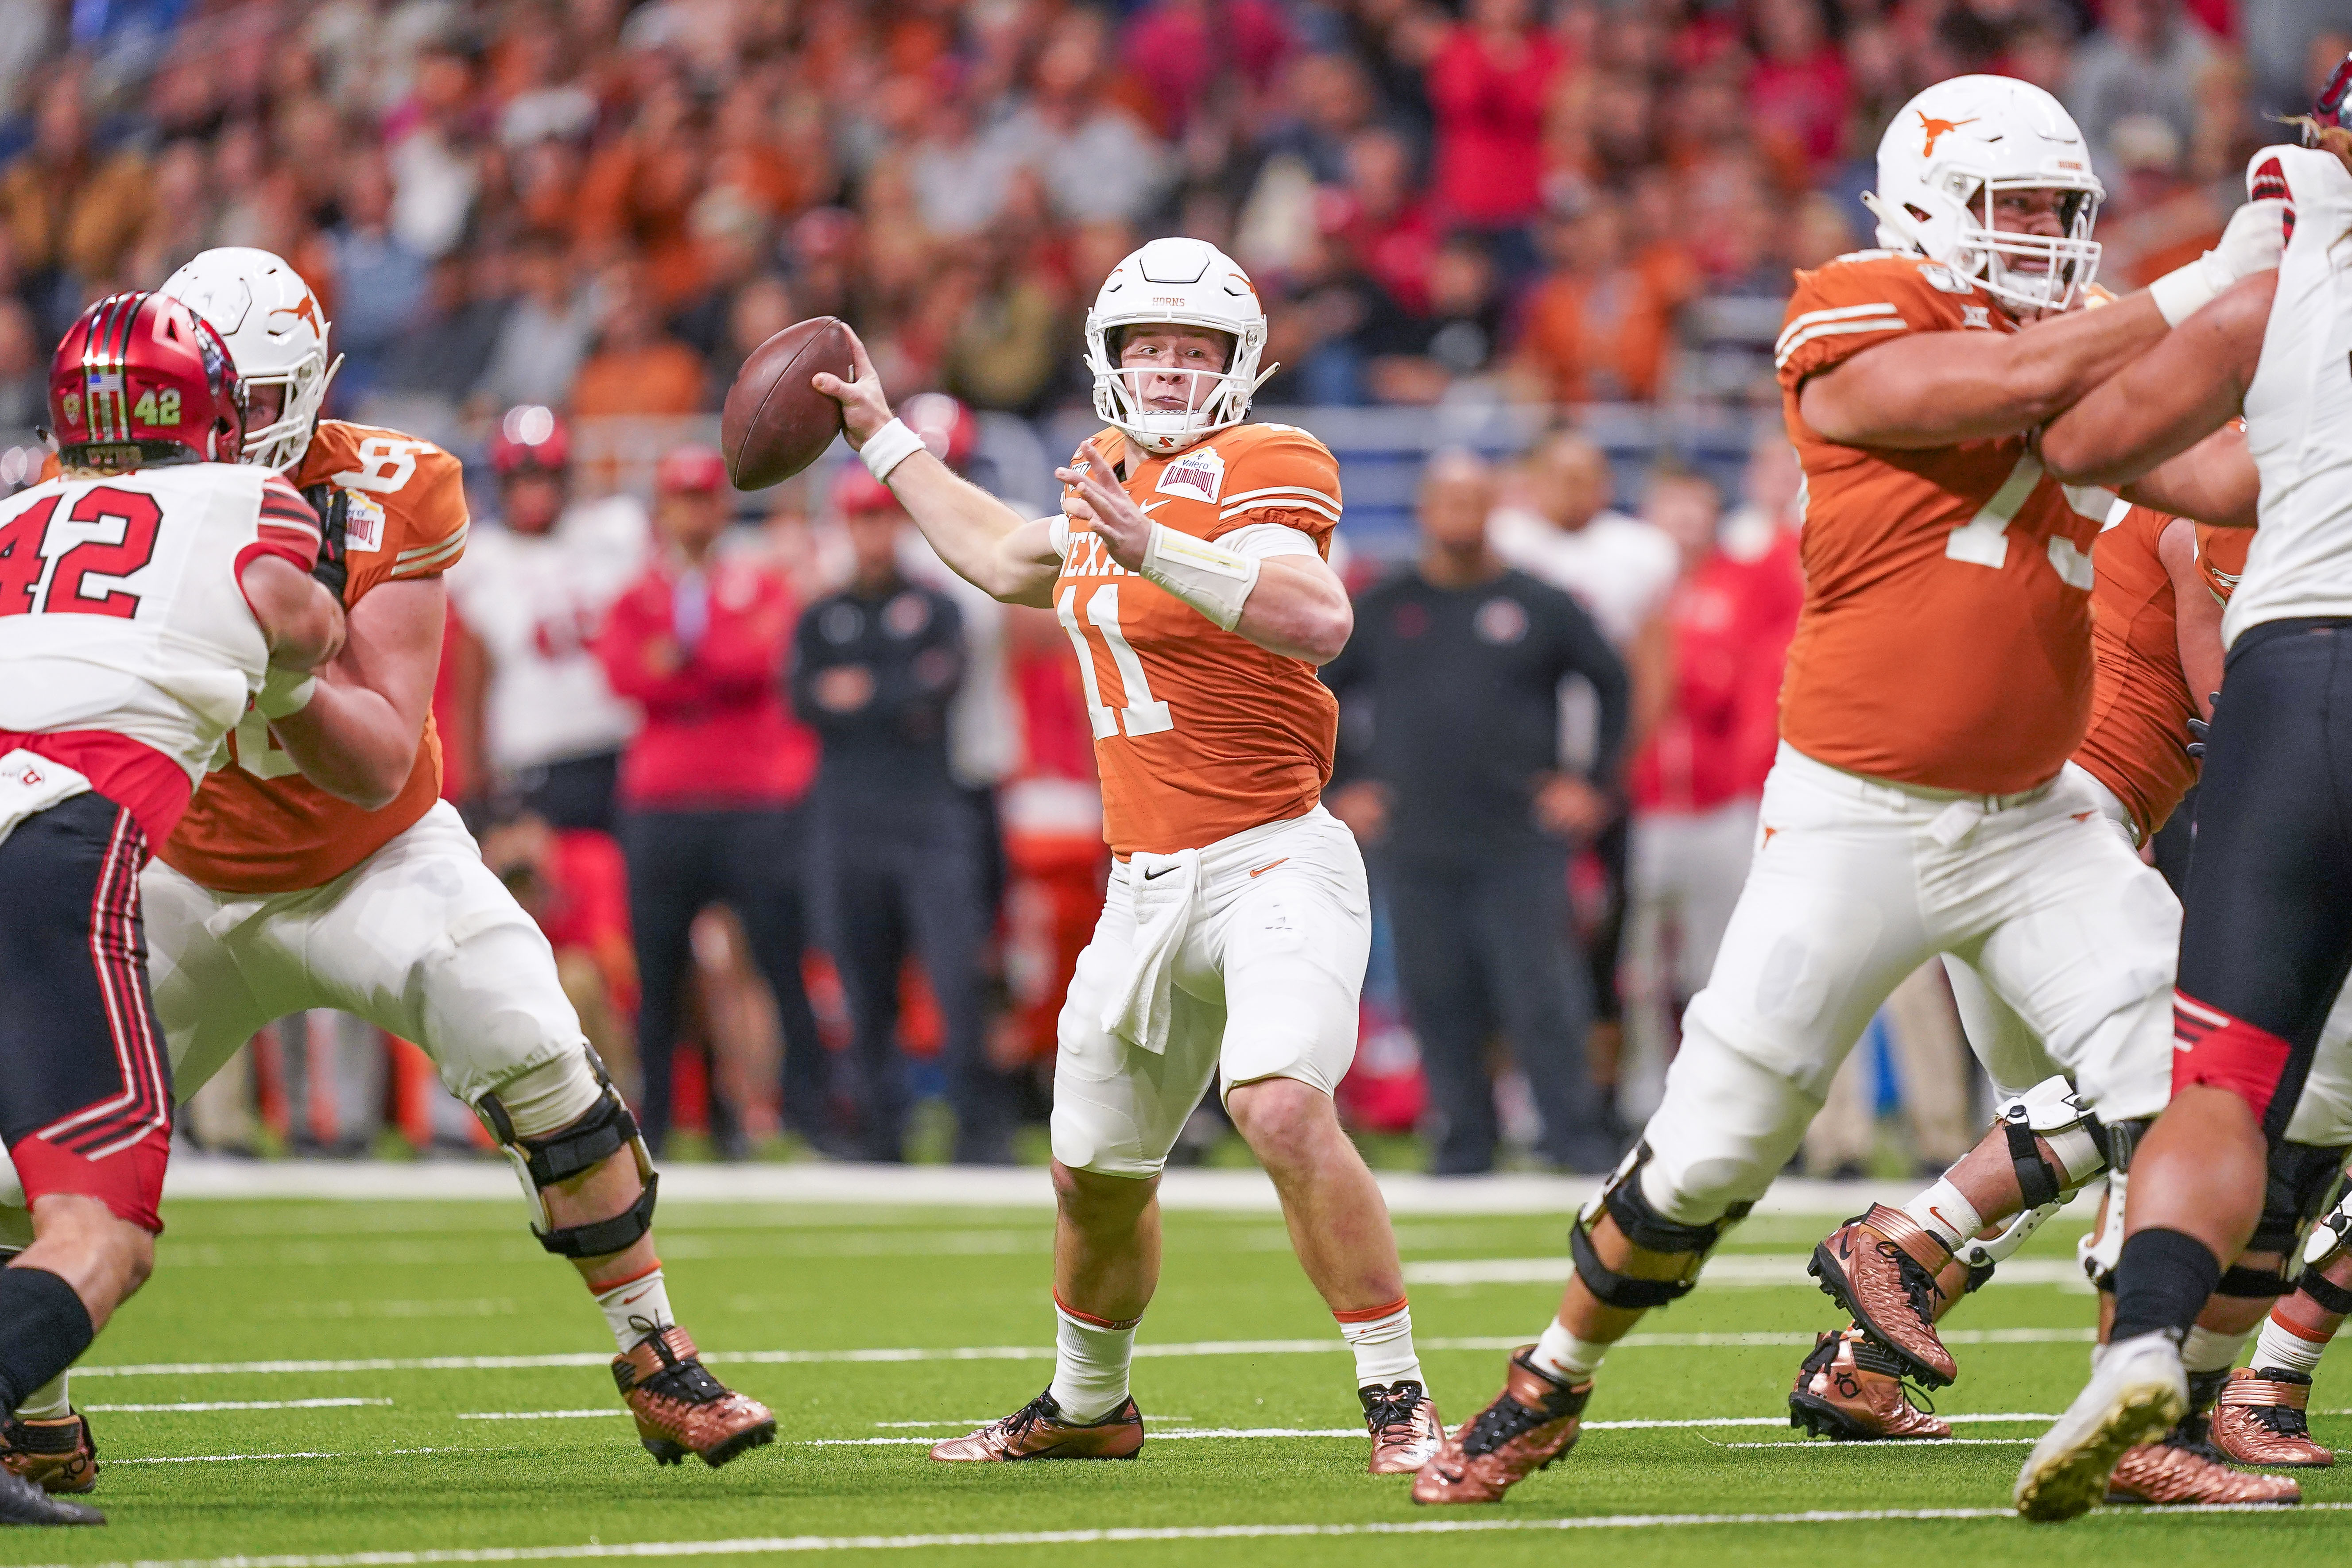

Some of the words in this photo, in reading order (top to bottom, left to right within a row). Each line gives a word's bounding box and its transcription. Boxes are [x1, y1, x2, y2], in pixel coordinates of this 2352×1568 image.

[1152, 298, 1185, 307] HORNS
[134, 387, 181, 426] 42
[1182, 459, 1209, 470] Valero
[0, 486, 163, 620] 42
[1057, 583, 1174, 740] 11
